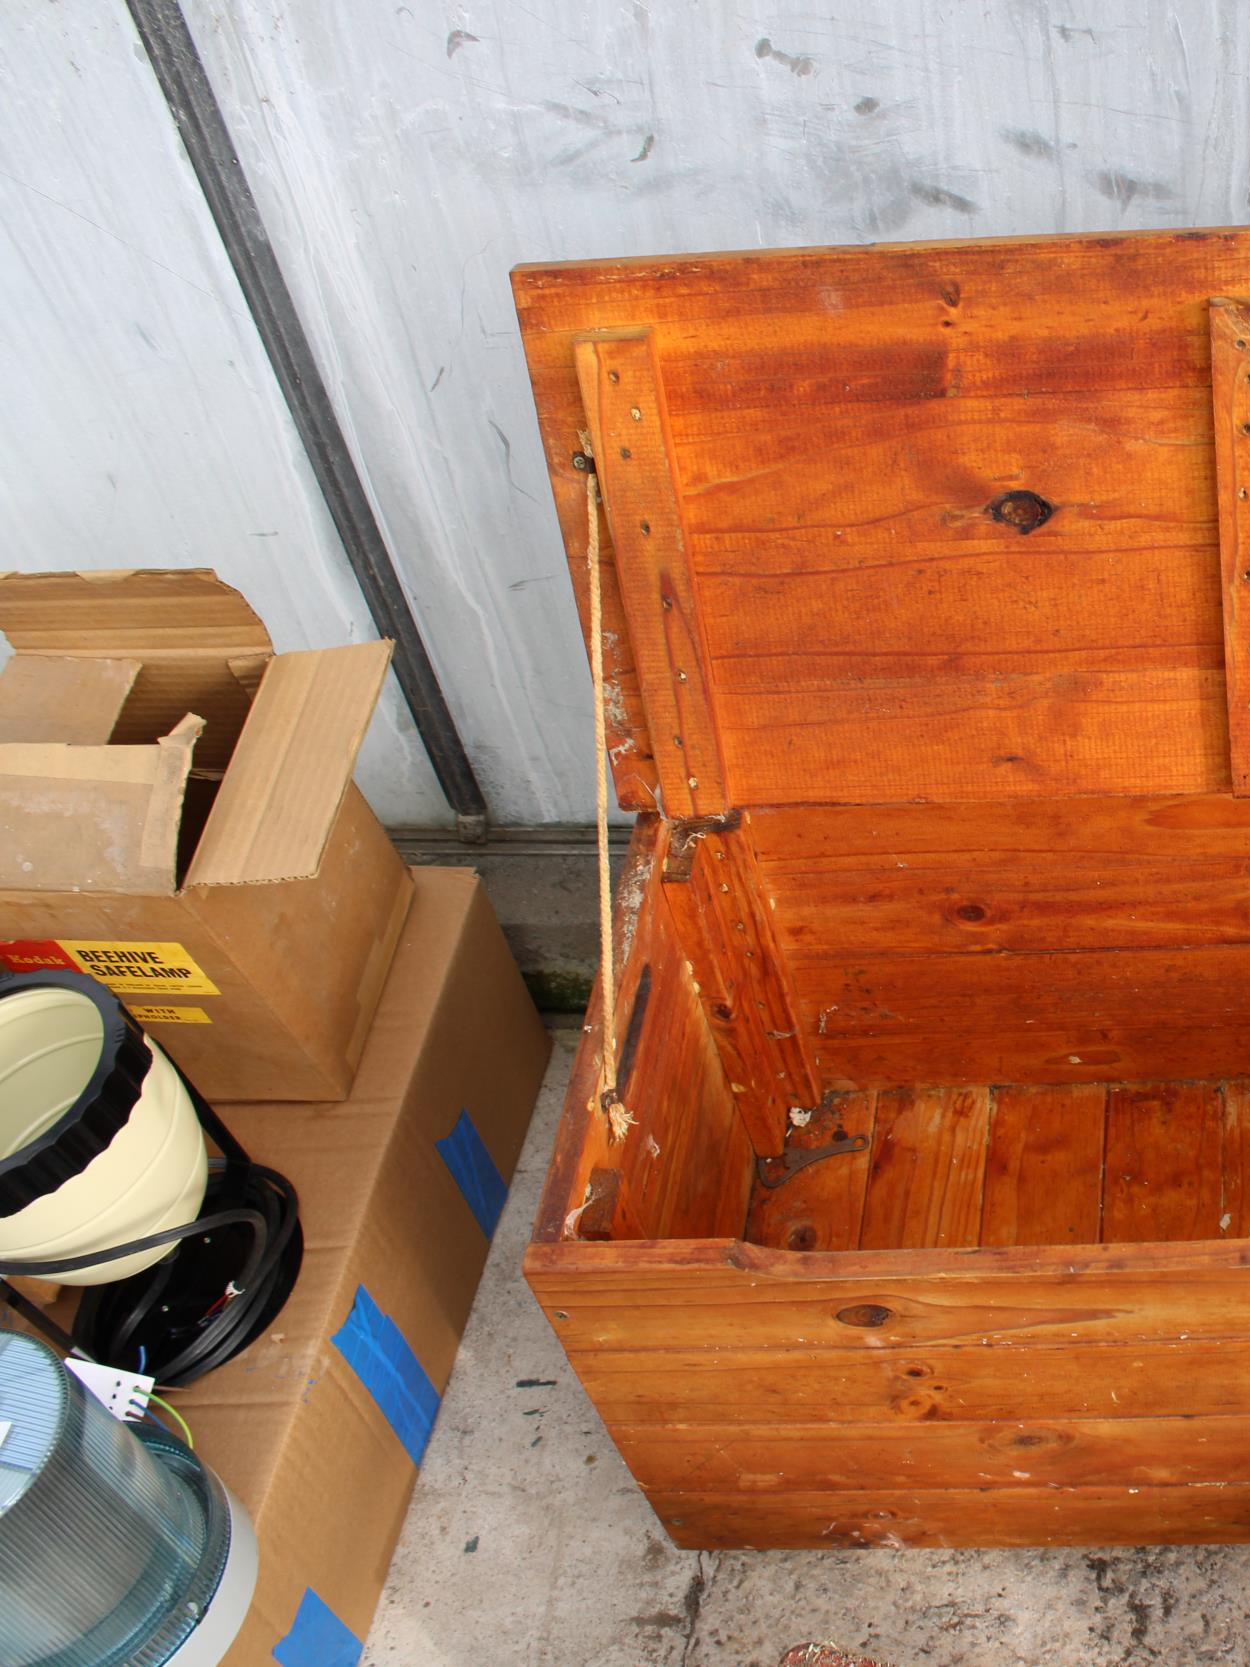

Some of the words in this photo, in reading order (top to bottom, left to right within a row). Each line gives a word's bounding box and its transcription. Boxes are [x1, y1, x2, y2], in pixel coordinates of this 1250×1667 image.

[7, 954, 66, 965] Kodak
[76, 950, 164, 964] BEEHIVE
[90, 964, 192, 979] SAFELAMP
